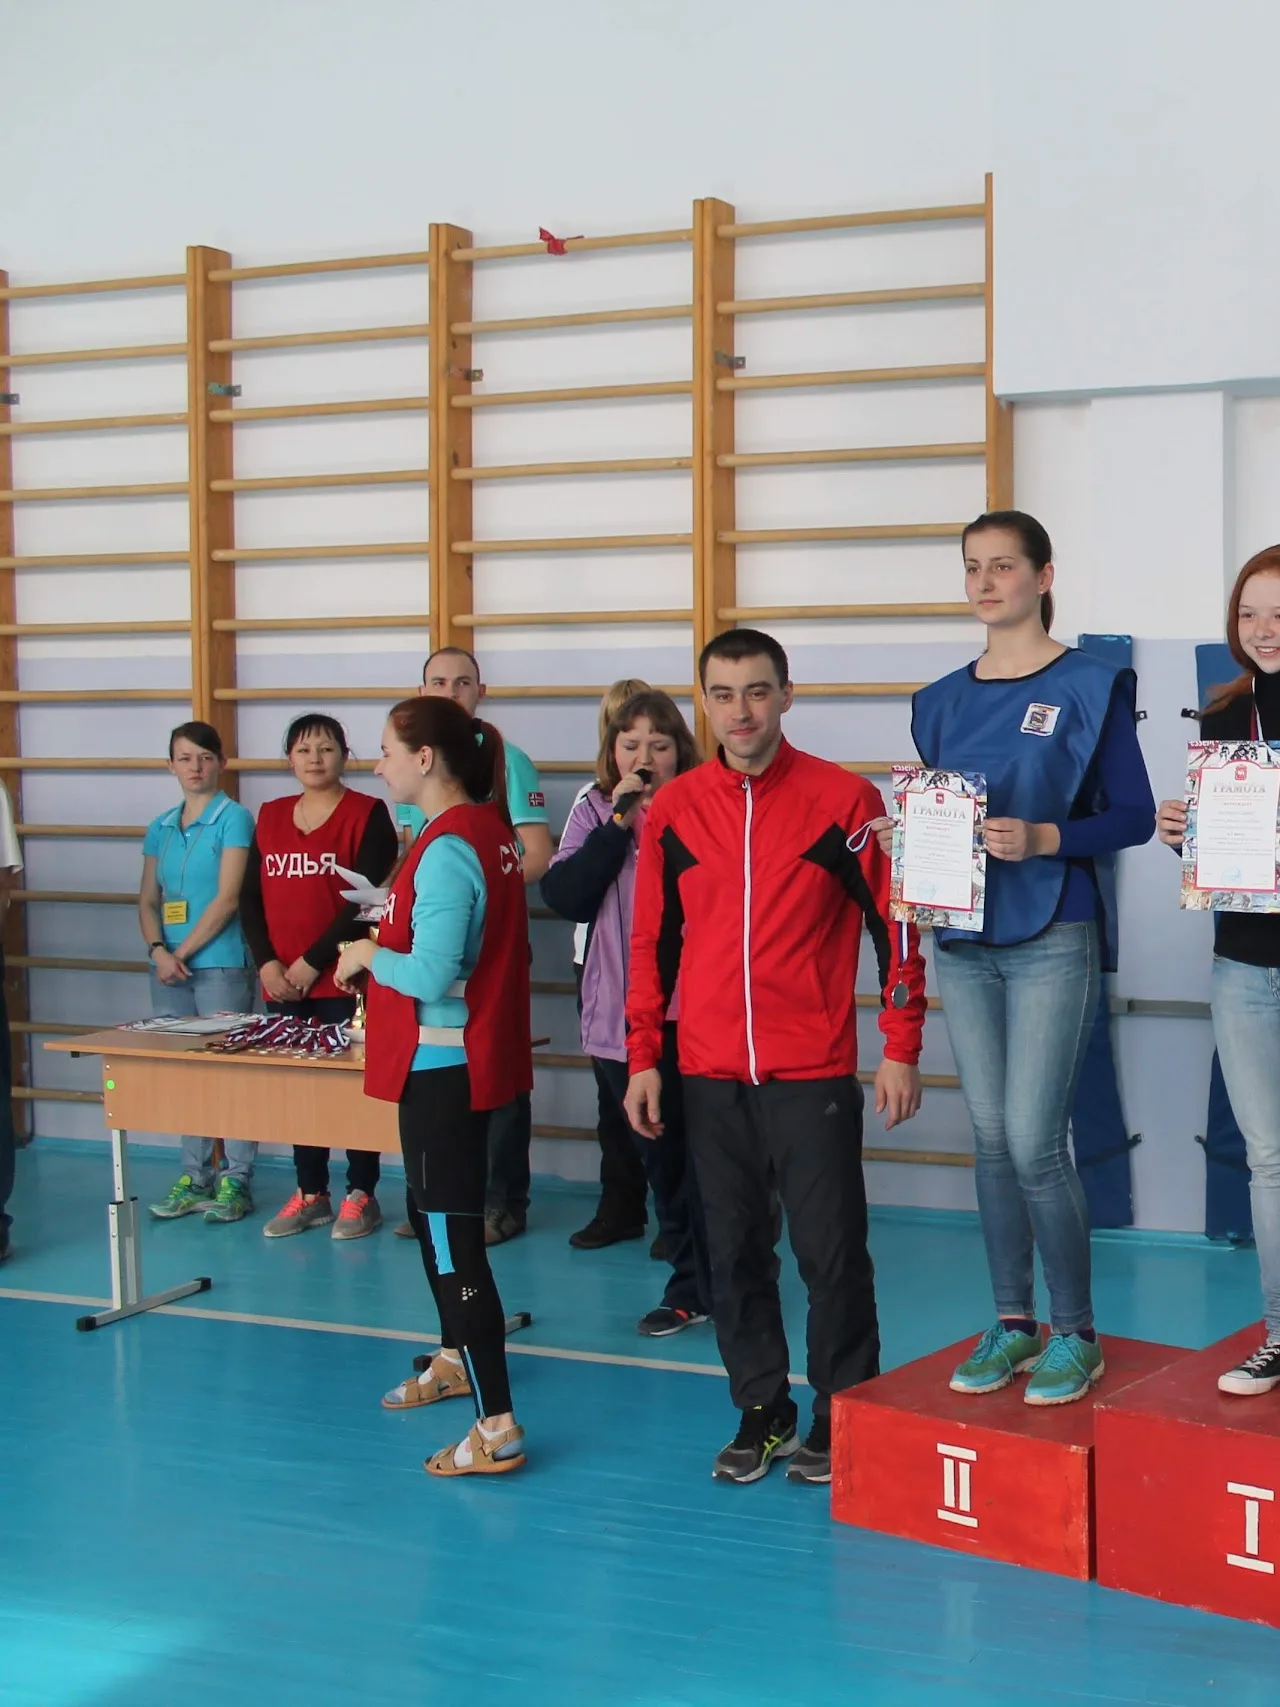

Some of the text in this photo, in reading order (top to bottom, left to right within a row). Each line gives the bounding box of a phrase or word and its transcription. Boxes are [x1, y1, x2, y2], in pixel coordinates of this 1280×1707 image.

[1212, 782, 1266, 793] ГРАМОТА
[912, 806, 966, 819] ГРАМОТА
[265, 852, 336, 878] СУДЬЯ
[937, 1442, 978, 1528] II
[1226, 1481, 1275, 1574] I
